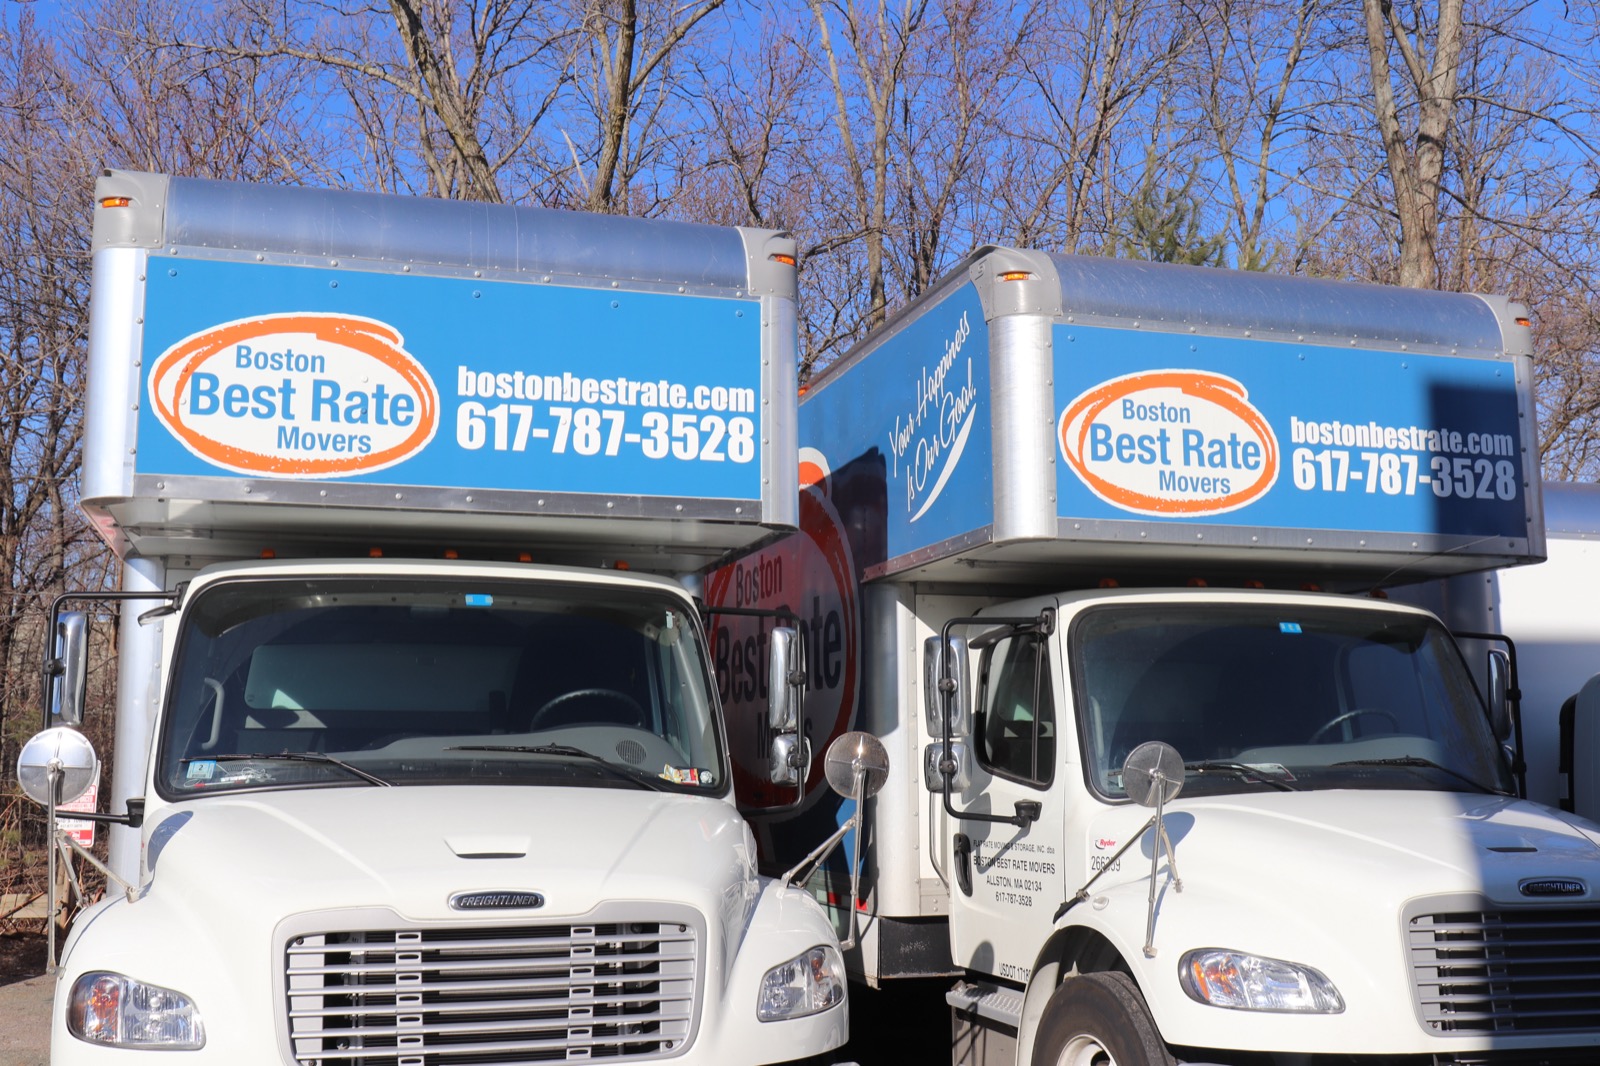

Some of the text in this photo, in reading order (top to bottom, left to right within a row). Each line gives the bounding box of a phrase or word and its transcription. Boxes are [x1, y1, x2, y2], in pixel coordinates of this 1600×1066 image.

[235, 345, 325, 373] Boston
[189, 372, 415, 427] Best Rate
[457, 365, 755, 413] bostonbestrate.com
[889, 310, 970, 478] Your Happiness
[1122, 398, 1191, 423] Boston
[276, 425, 372, 454] Movers
[456, 401, 755, 463] 617-787-3528
[907, 356, 976, 513] Is Our Goal.
[1089, 422, 1261, 470] Best Rate
[1290, 415, 1514, 457] bostonbestrate.com
[1158, 470, 1231, 494] Movers
[1292, 447, 1517, 501] 617-787-3528
[736, 554, 783, 608] Boston
[983, 840, 993, 849] RATE
[1100, 839, 1116, 847] Ryder
[973, 855, 1055, 875] BOSTON BEST RATE MOVERS
[995, 891, 1032, 907] 617-787-3528
[1014, 879, 1023, 890] MA
[1024, 880, 1042, 892] 02134
[460, 895, 535, 906] FREIGHTLINER
[999, 962, 1016, 979] USDOT
